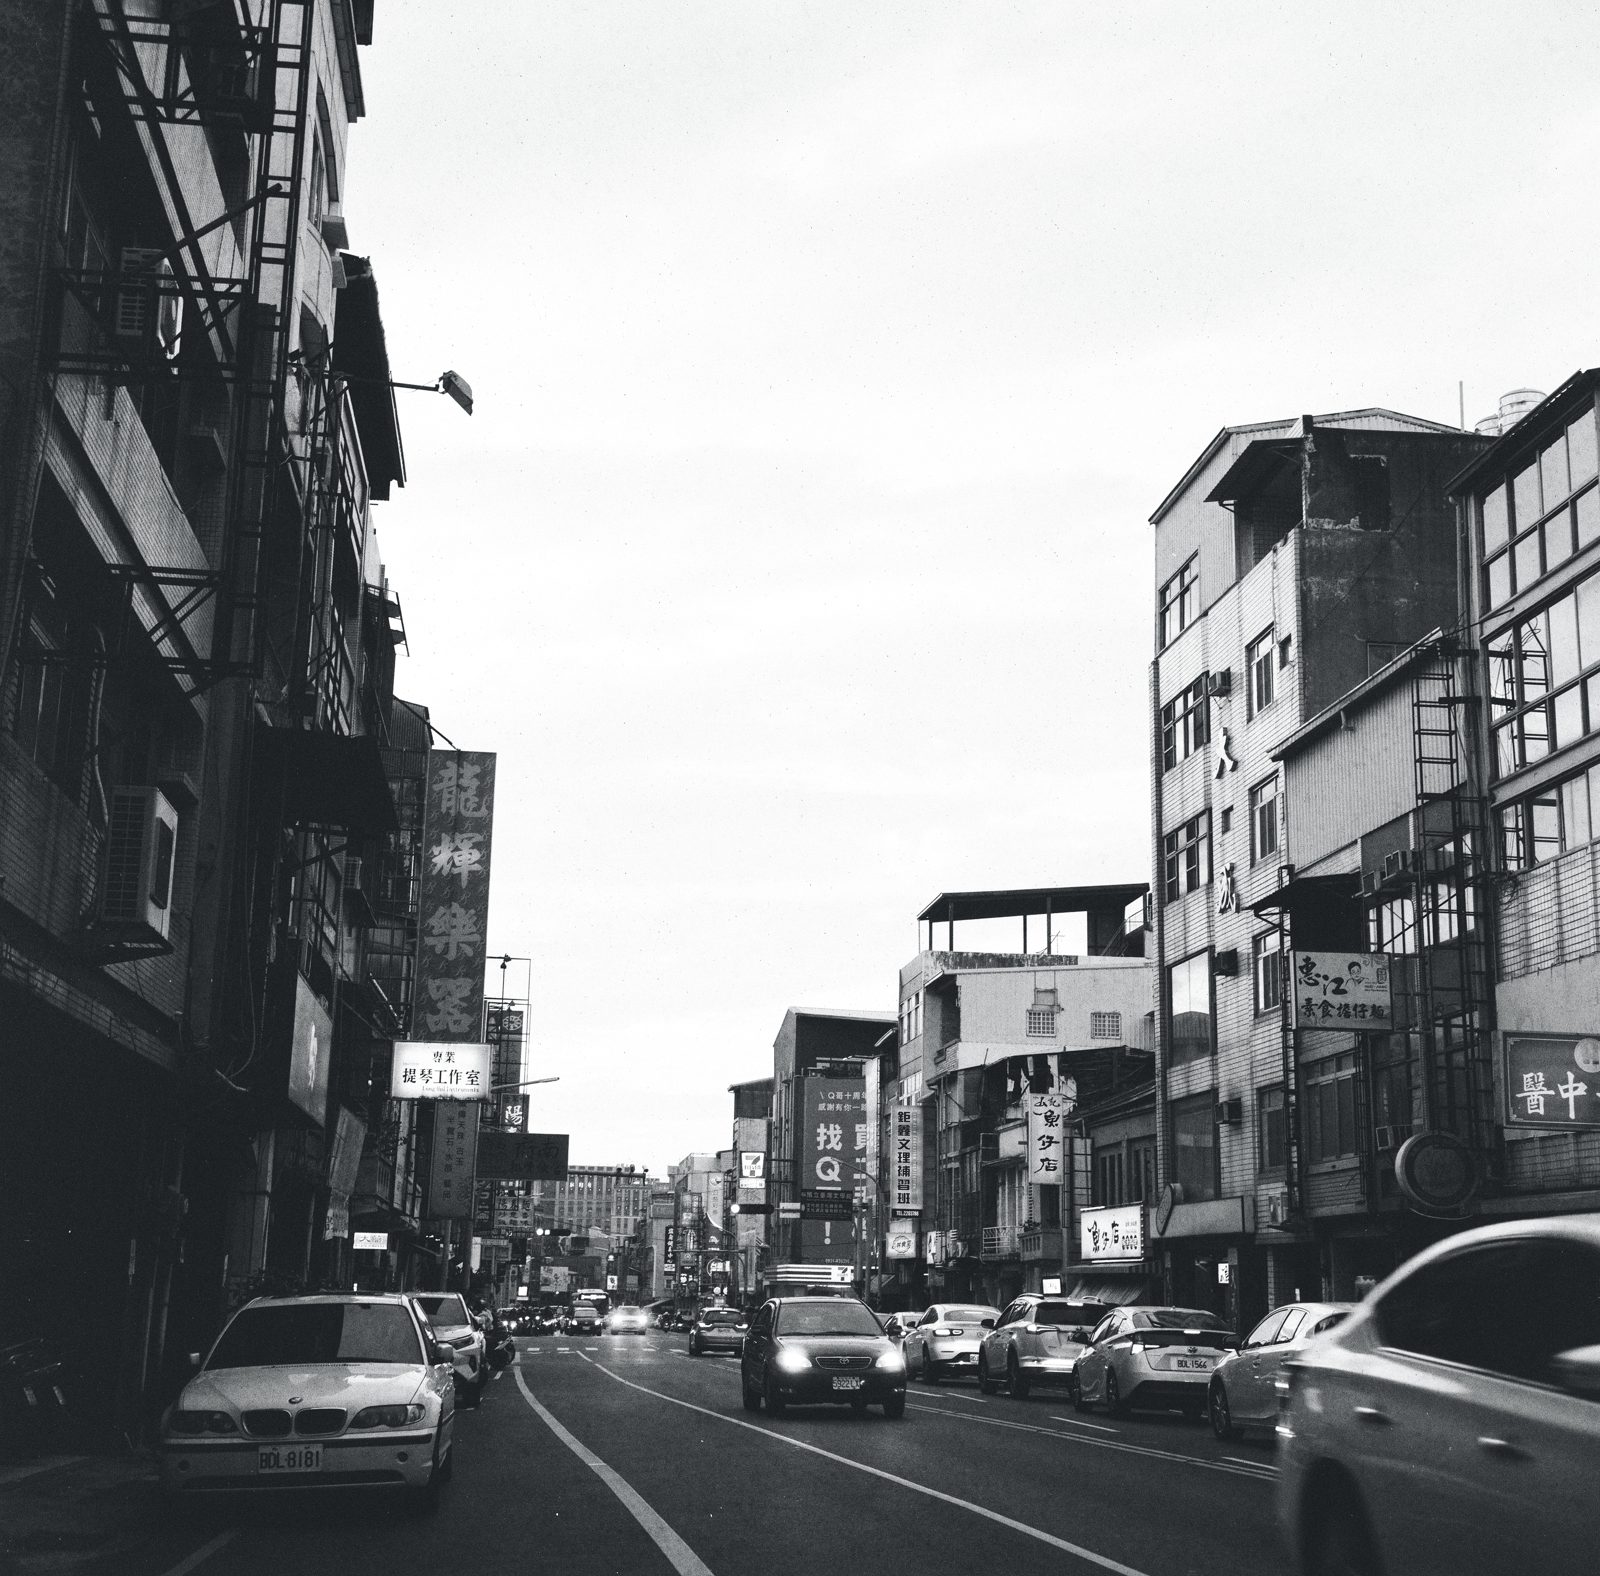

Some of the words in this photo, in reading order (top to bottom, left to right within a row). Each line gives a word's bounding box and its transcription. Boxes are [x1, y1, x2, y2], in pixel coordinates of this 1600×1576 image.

[424, 759, 488, 1034] 龍輝樂器
[402, 1067, 481, 1086] 提琴工作室
[1033, 1109, 1061, 1173] 魚仔店
[1087, 1220, 1120, 1254] 魚仔店
[259, 1450, 320, 1469] BDL-8181
